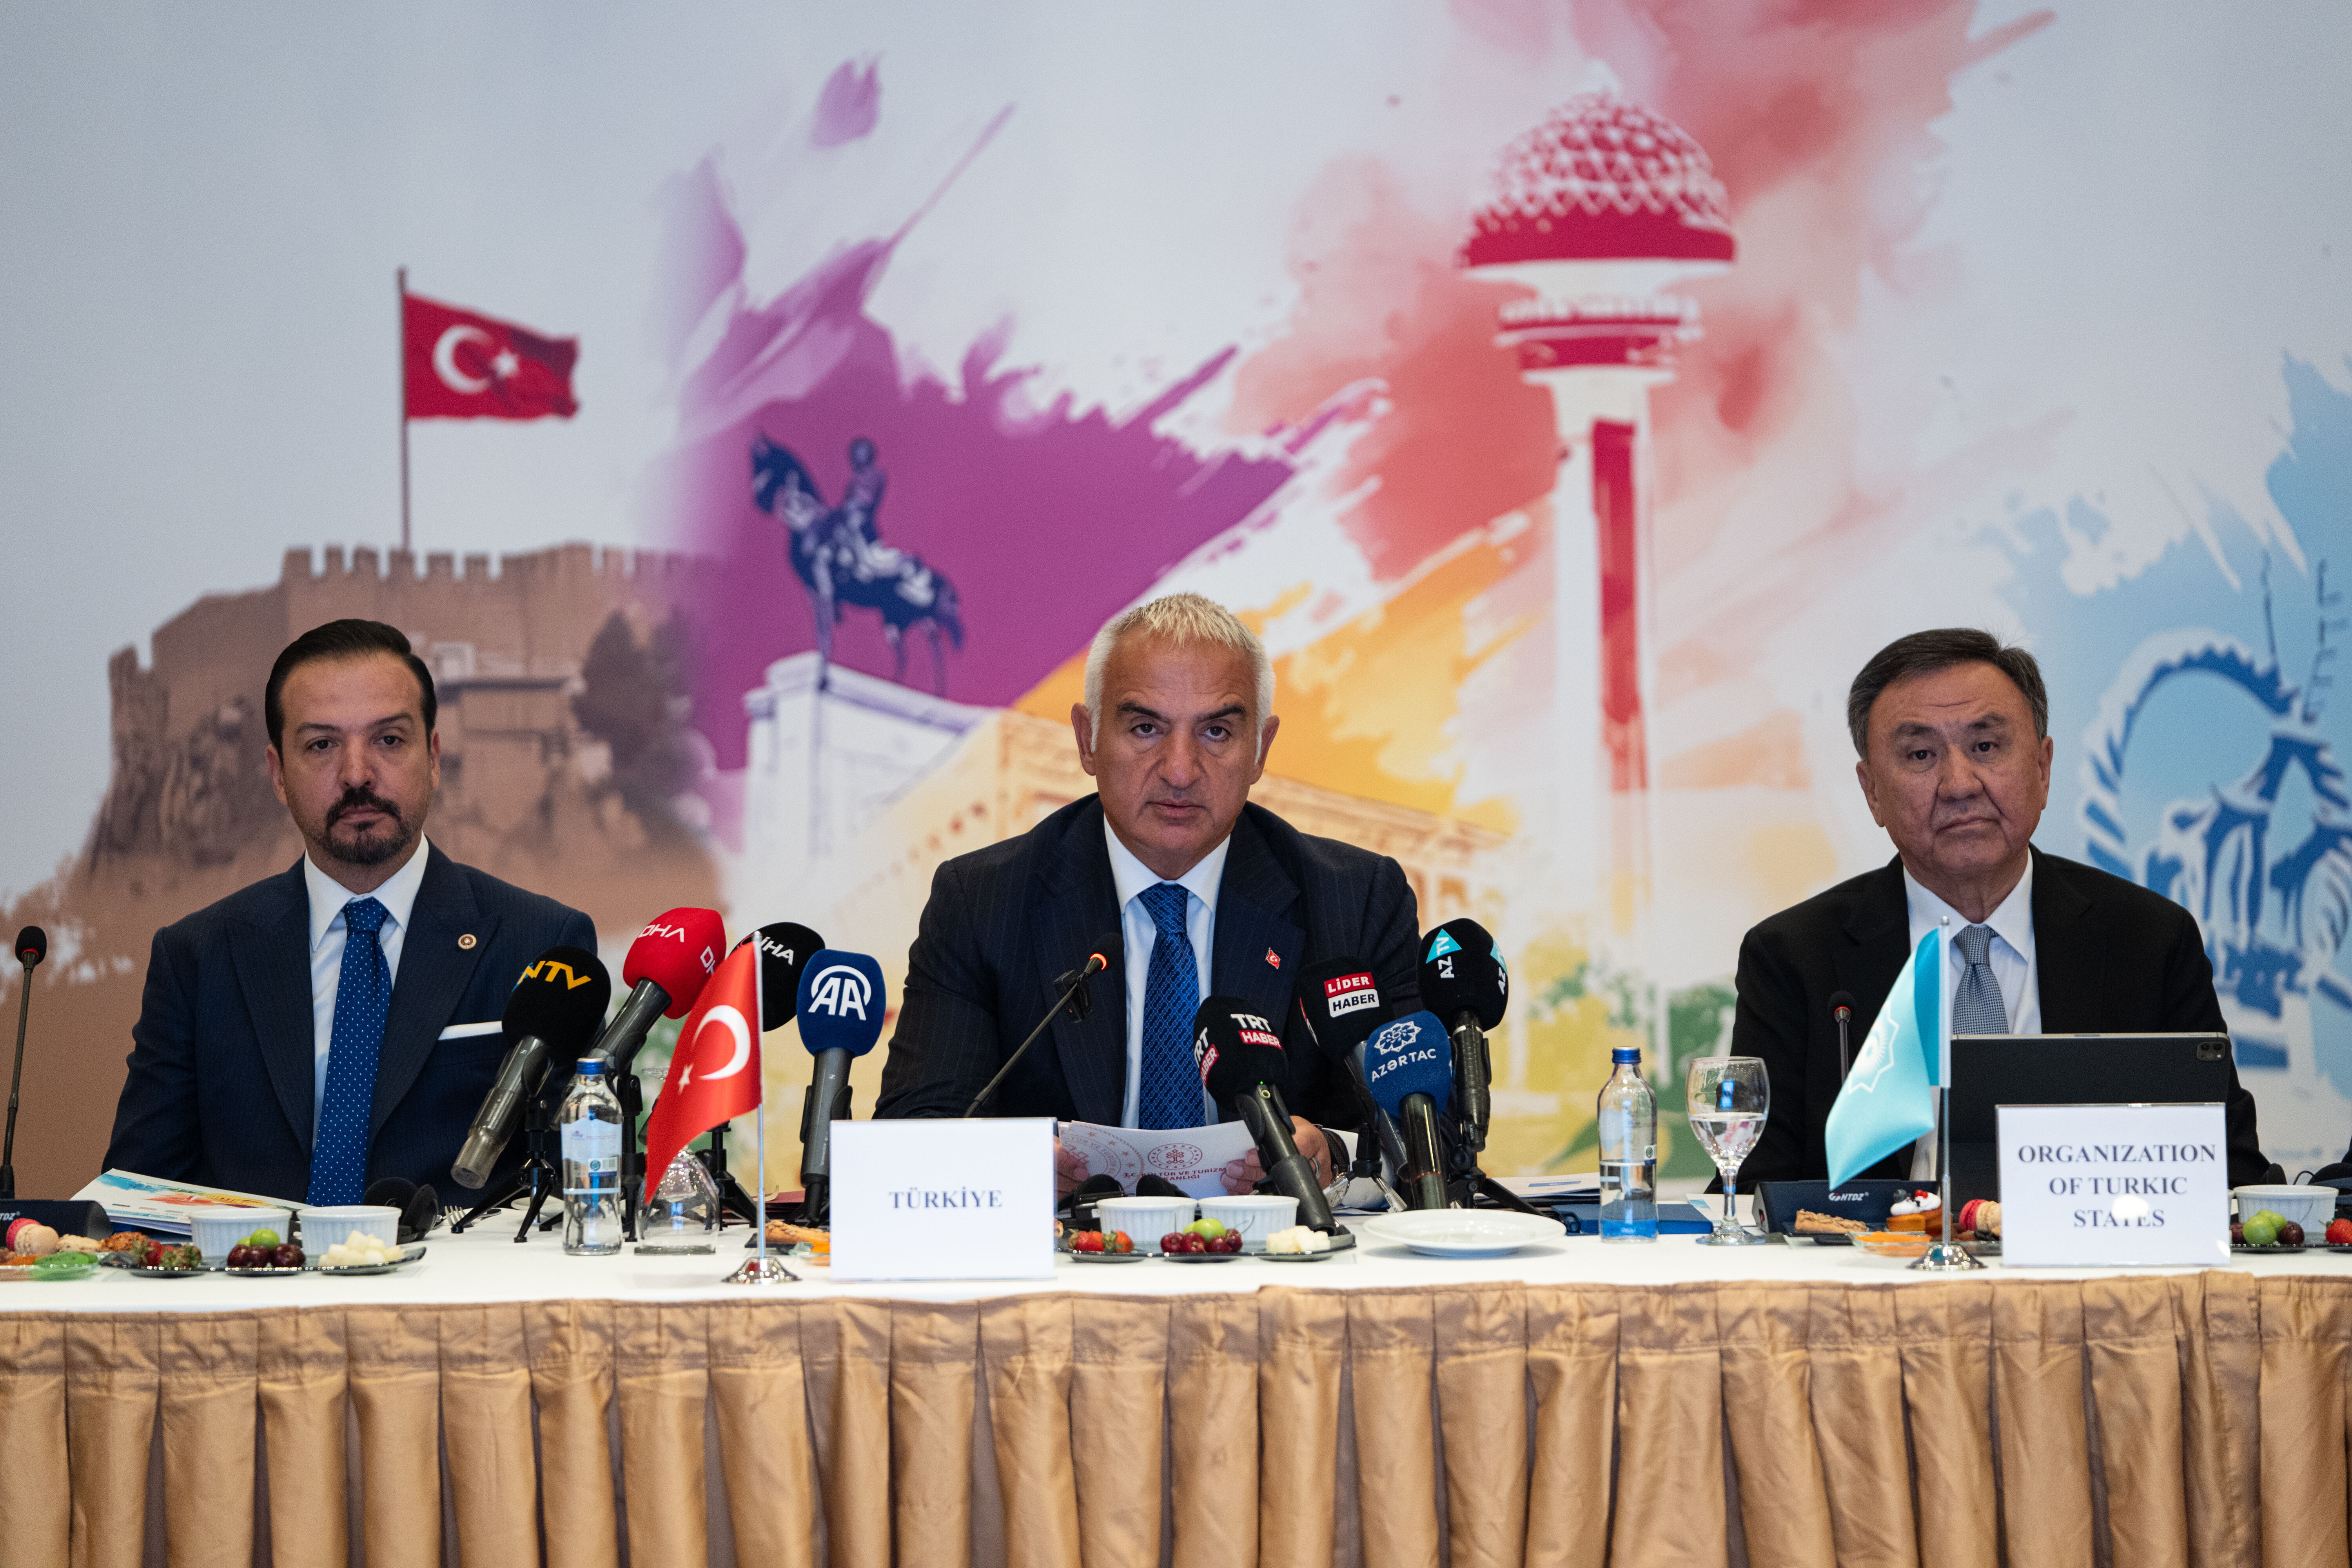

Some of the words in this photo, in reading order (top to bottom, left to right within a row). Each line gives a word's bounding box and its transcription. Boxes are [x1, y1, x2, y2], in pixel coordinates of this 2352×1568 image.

[638, 924, 684, 943] DHA
[517, 960, 592, 990] NTV
[808, 977, 866, 1021] AA
[1332, 994, 1376, 1011] HABER
[1230, 1014, 1272, 1032] TRT
[1241, 1032, 1281, 1048] HABER
[2018, 1144, 2216, 1163] ORGANIZATION
[2049, 1177, 2083, 1194] OF
[2088, 1177, 2187, 1194] TURKIC
[888, 1186, 1003, 1209] TÜRKİYE
